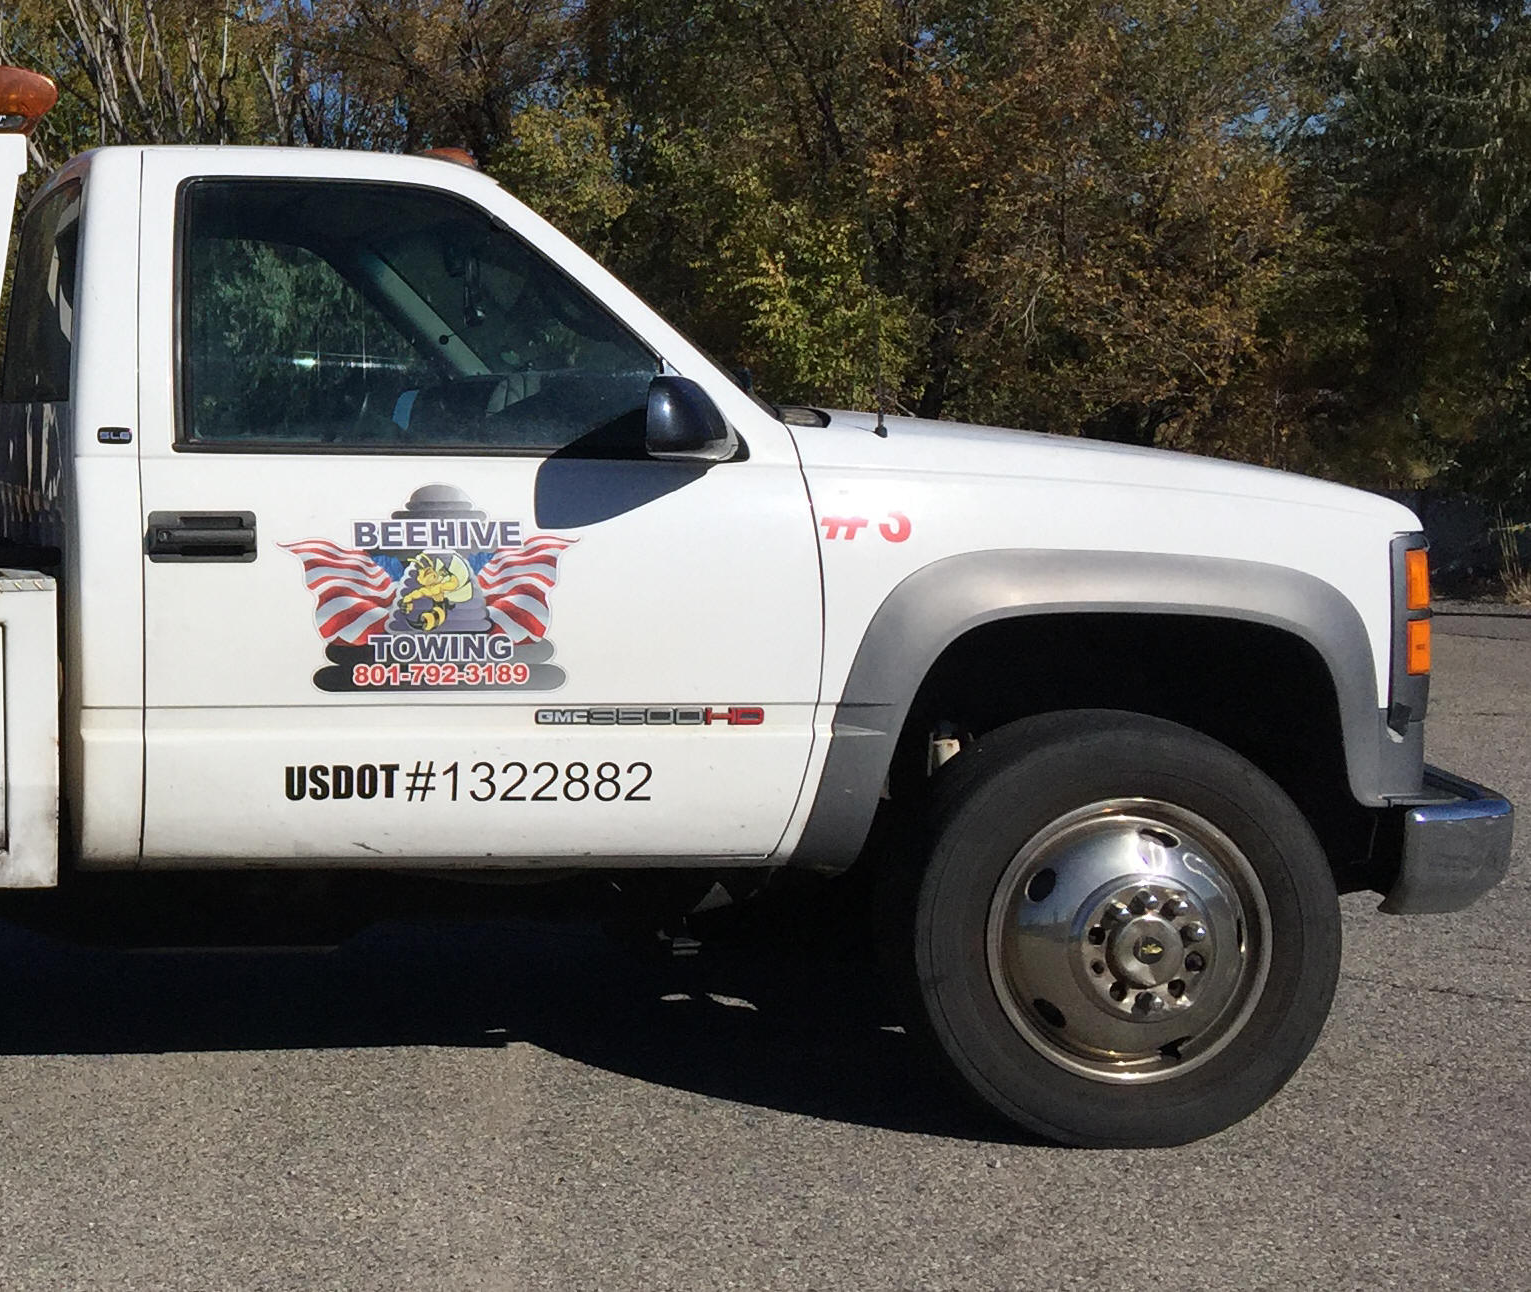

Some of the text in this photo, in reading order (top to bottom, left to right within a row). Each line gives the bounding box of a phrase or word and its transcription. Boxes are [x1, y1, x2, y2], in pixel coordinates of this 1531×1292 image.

[353, 521, 523, 548] BEEHIVE
[369, 636, 514, 663] TOWING
[353, 663, 530, 686] 801-792-3189
[285, 761, 653, 802] USDOT #1322882
